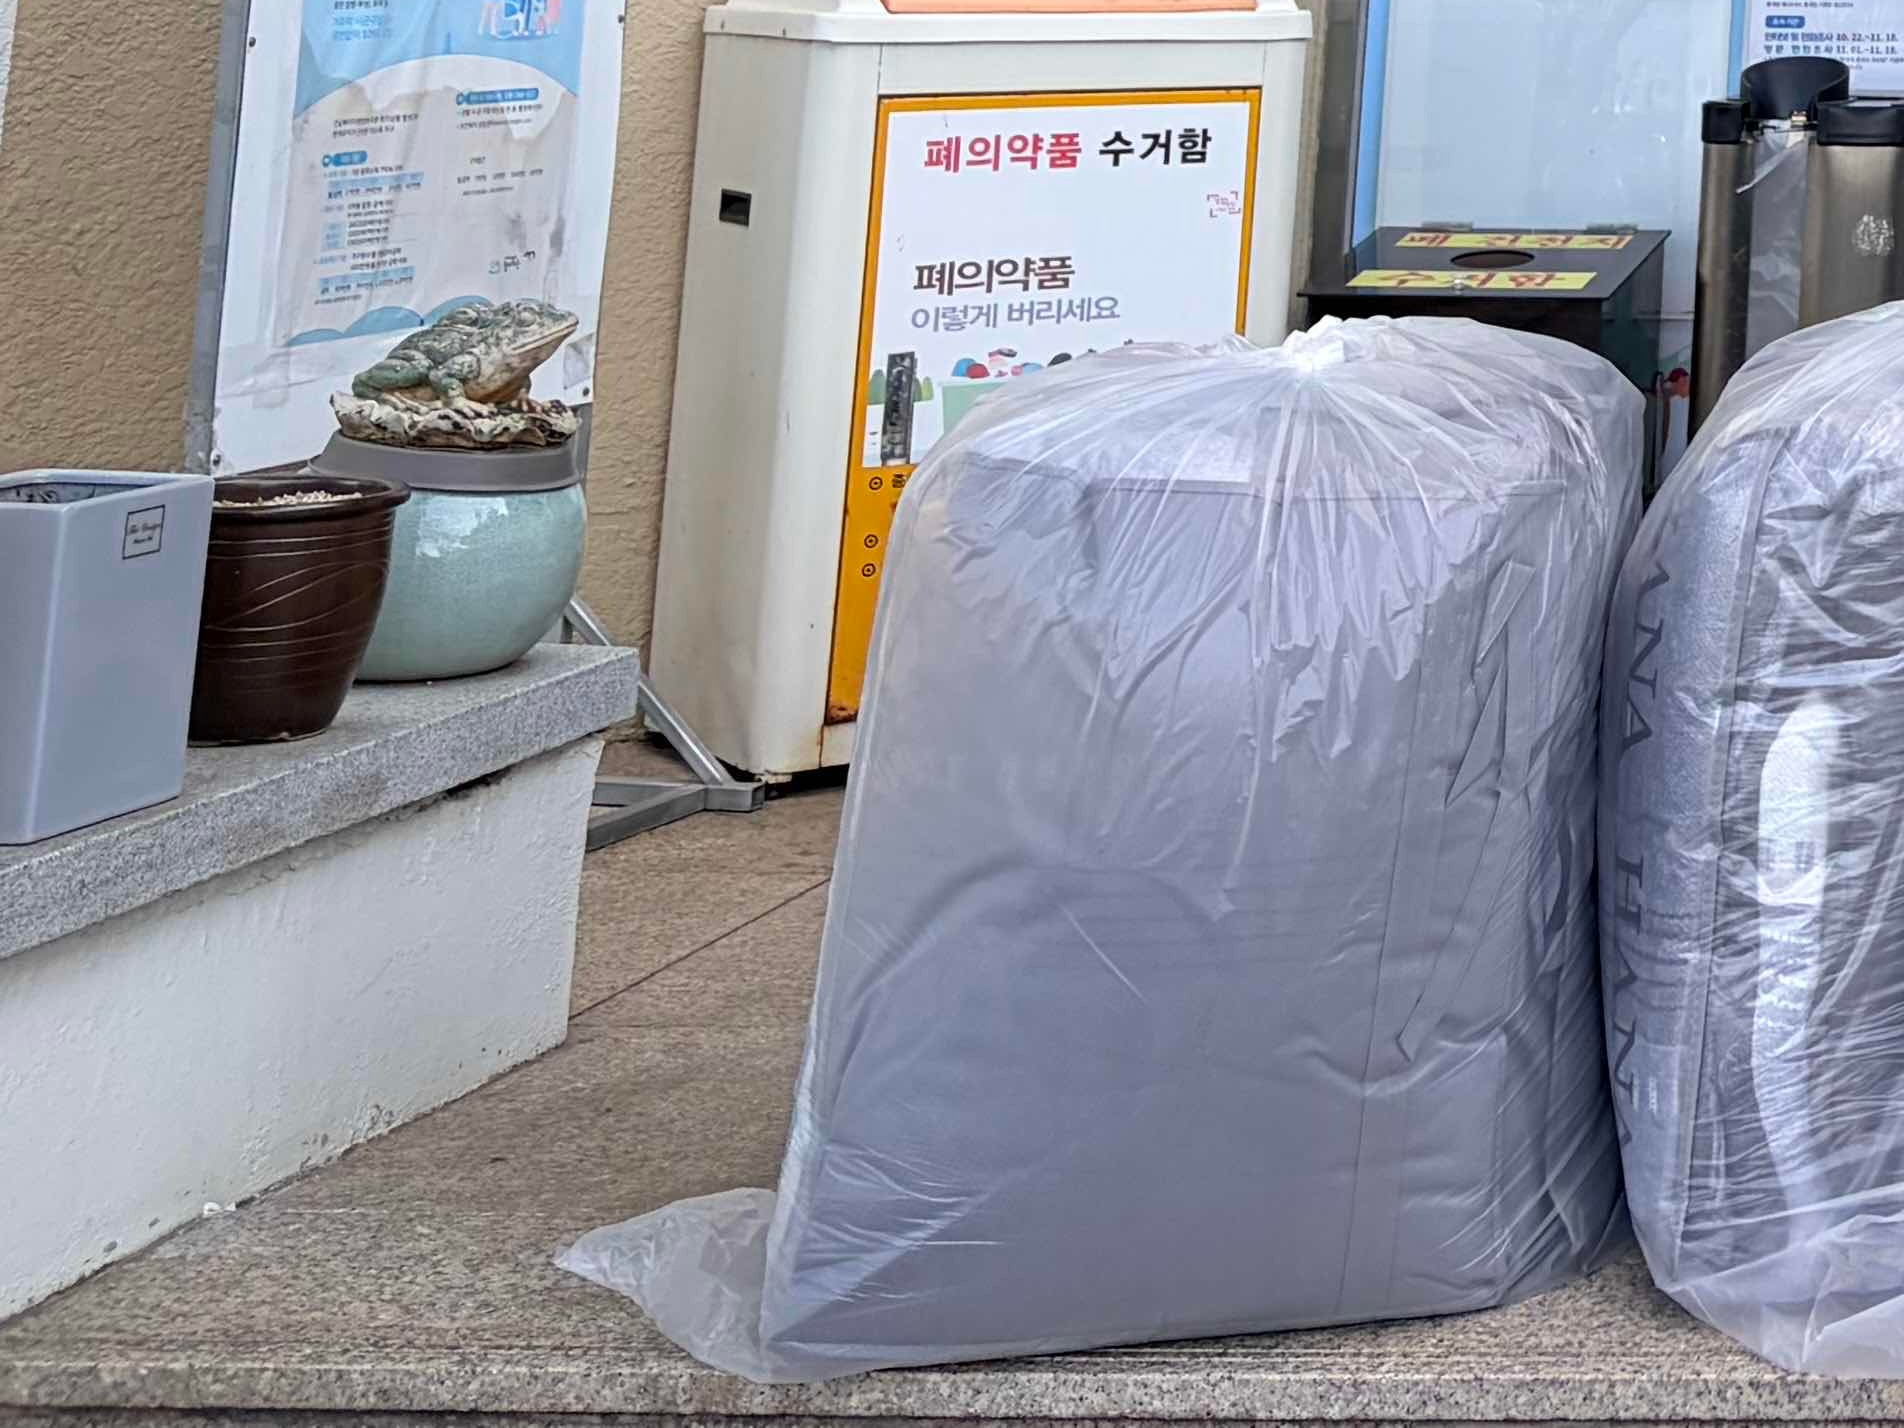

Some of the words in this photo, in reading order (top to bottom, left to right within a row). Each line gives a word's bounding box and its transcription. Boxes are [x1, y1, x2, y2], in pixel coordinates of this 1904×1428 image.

[923, 131, 1082, 173] 폐의약품
[1098, 127, 1213, 168] 수거함
[913, 255, 1076, 296] 폐의약품
[911, 303, 998, 332] 이렇게
[1006, 295, 1121, 326] 버리세요
